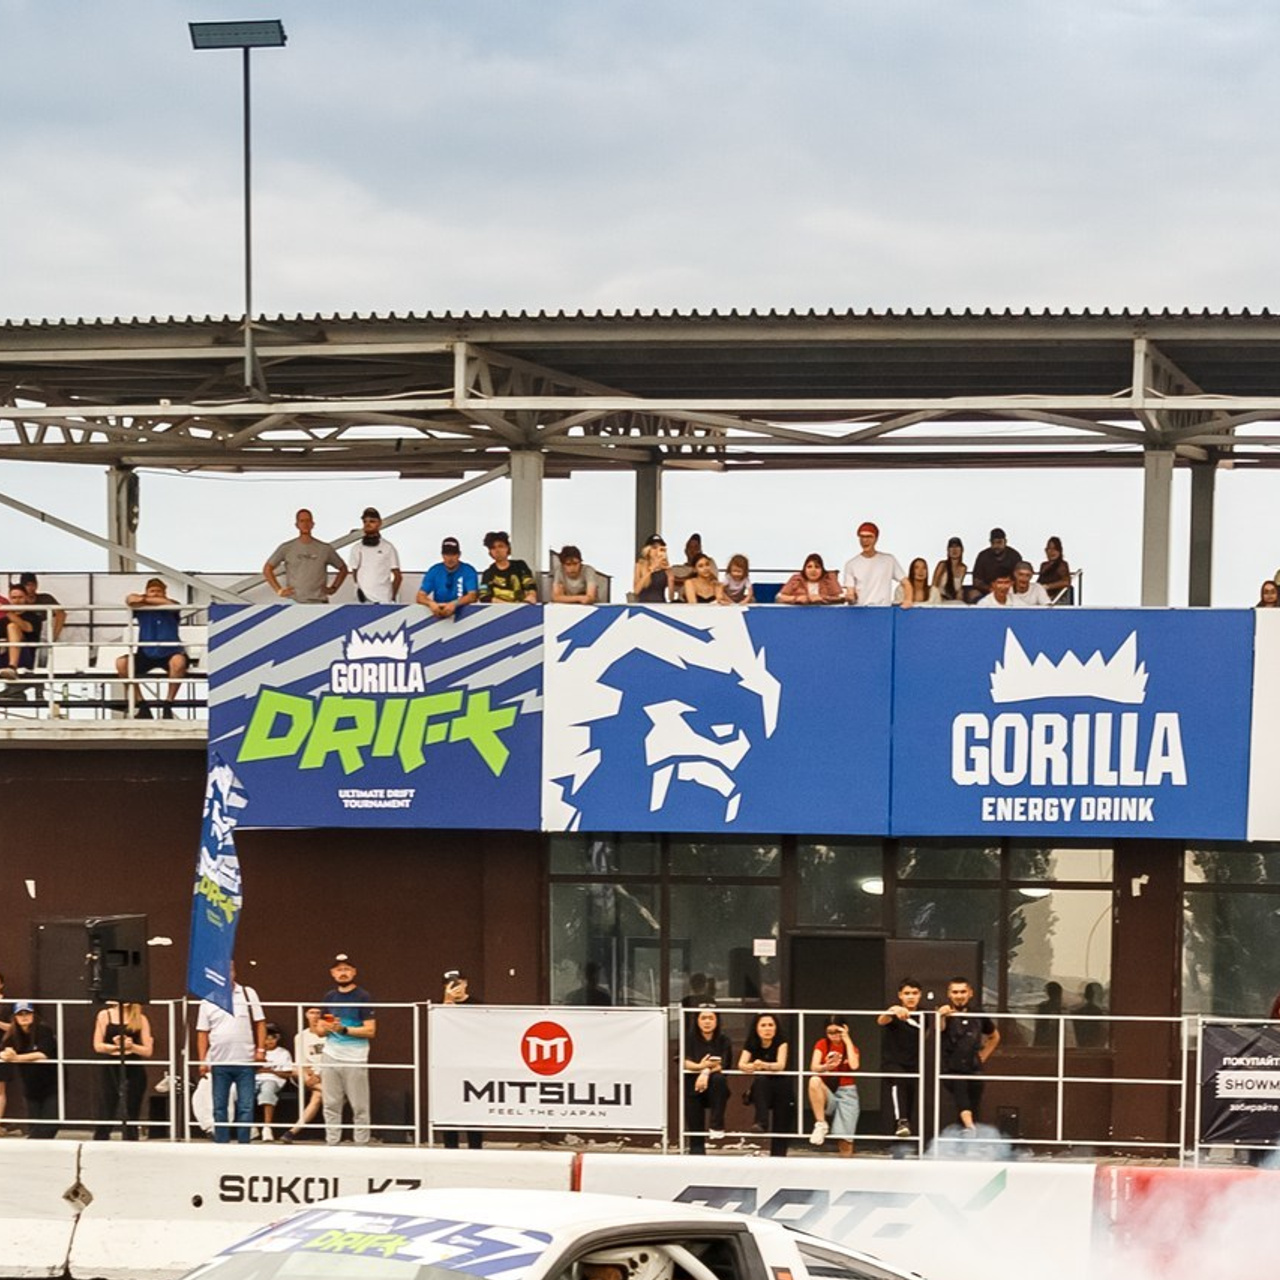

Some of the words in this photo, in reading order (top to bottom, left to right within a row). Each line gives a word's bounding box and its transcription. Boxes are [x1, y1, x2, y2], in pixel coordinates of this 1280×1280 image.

[331, 662, 426, 693] GORILLA
[952, 712, 1188, 786] GORILLA
[338, 789, 385, 798] ULTIMATE
[387, 789, 416, 798] DRIFT
[342, 799, 412, 808] TOURNAMENT
[982, 797, 1076, 822] ENERGY
[1080, 797, 1155, 822] DRINK
[463, 1079, 632, 1106] MITSUJI
[488, 1108, 523, 1116] FEEL
[530, 1109, 554, 1117] THE
